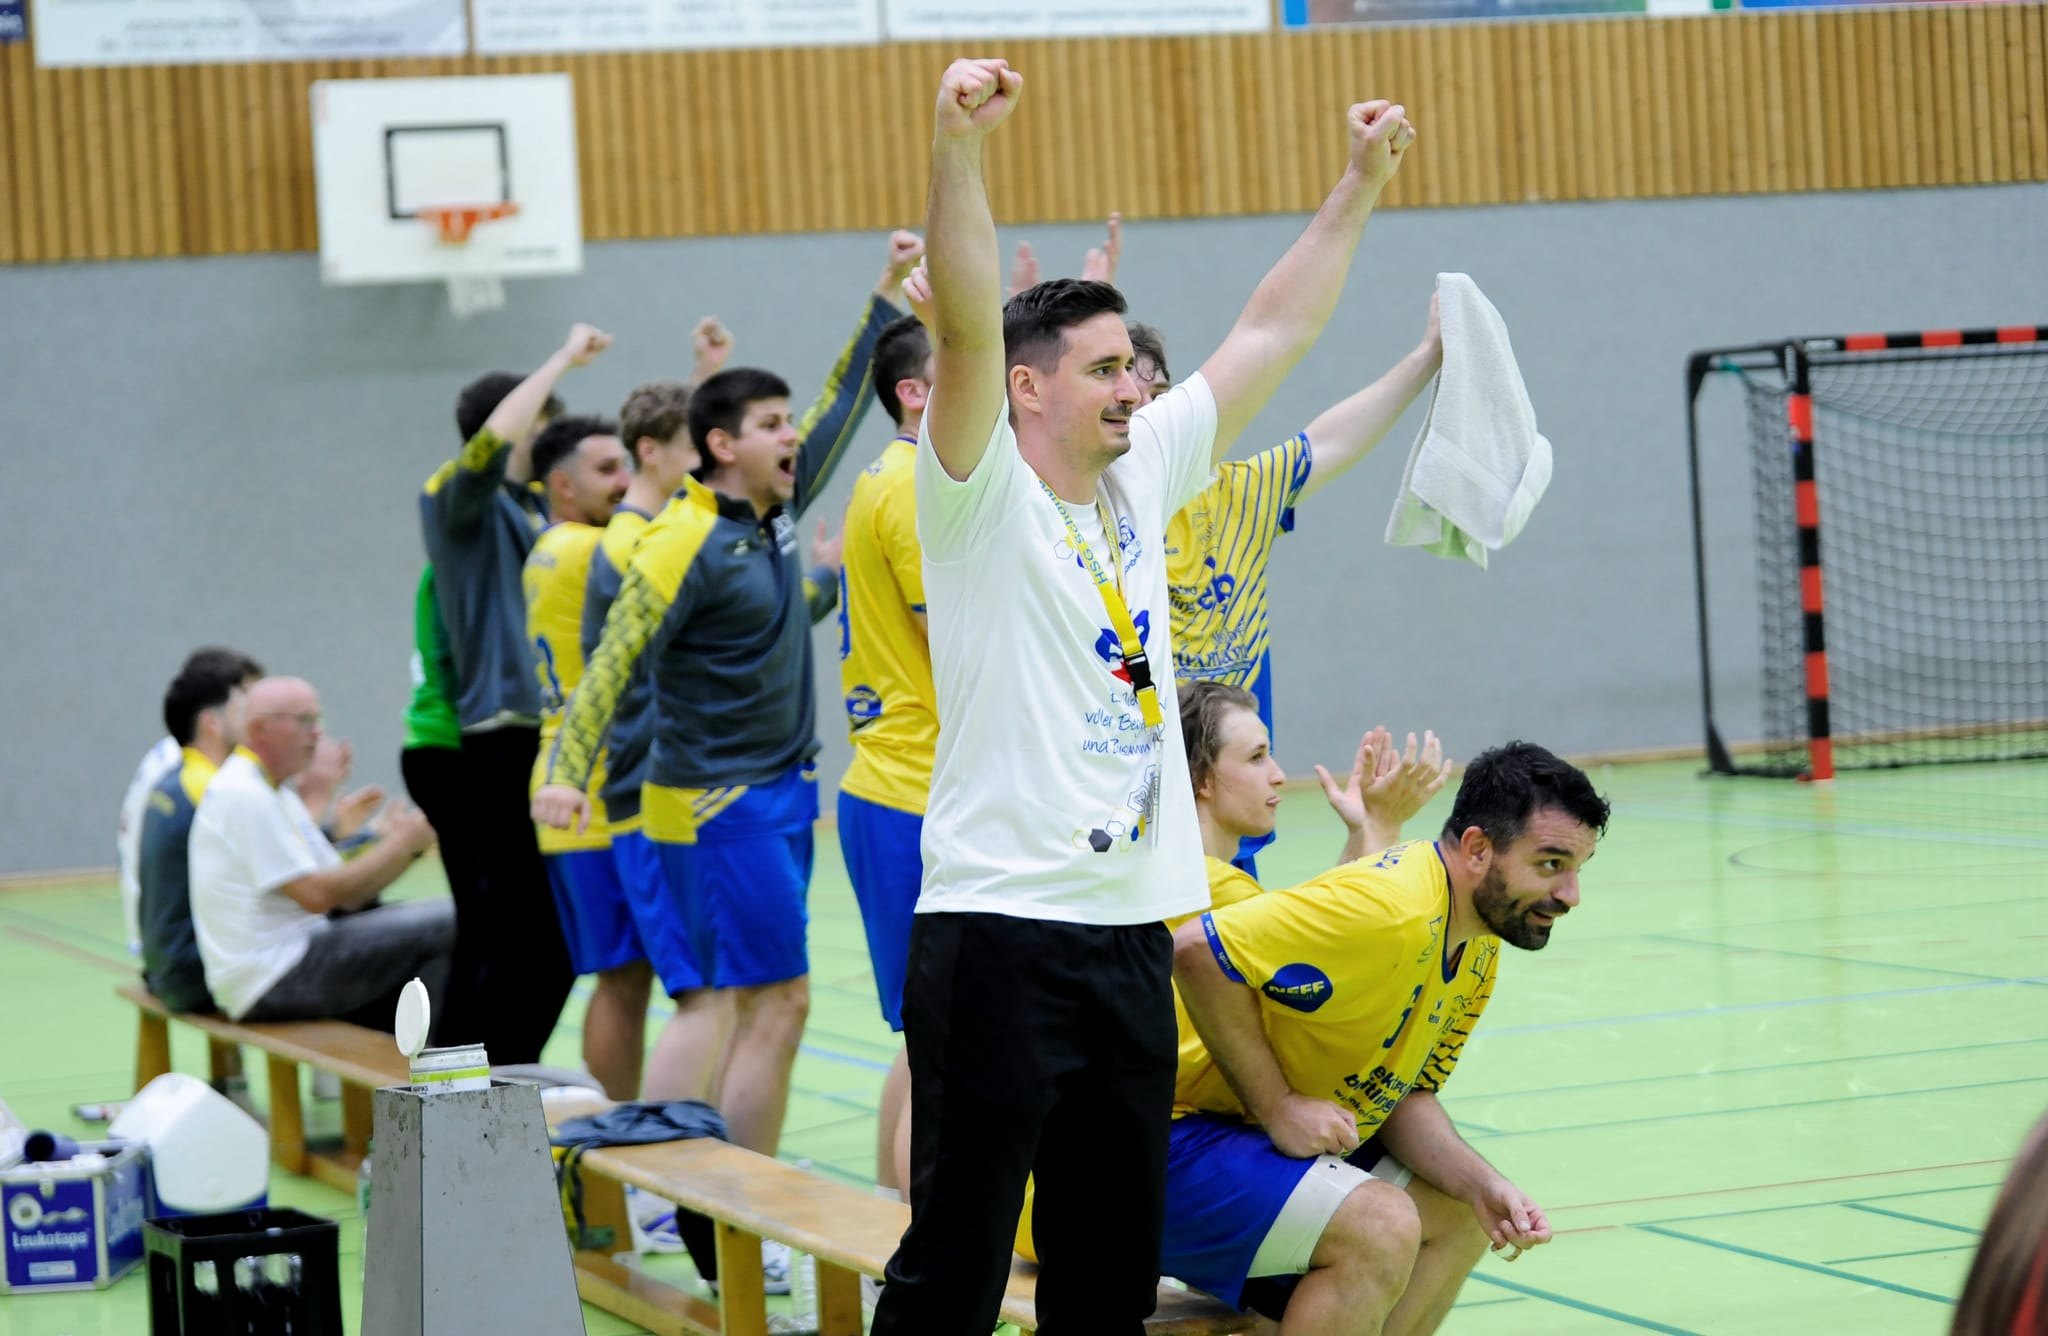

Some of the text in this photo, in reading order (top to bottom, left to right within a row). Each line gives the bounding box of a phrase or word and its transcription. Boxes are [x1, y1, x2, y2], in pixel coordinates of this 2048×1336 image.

[1083, 548, 1108, 585] HSG
[1082, 737, 1108, 753] und
[1268, 980, 1325, 996] NEFF
